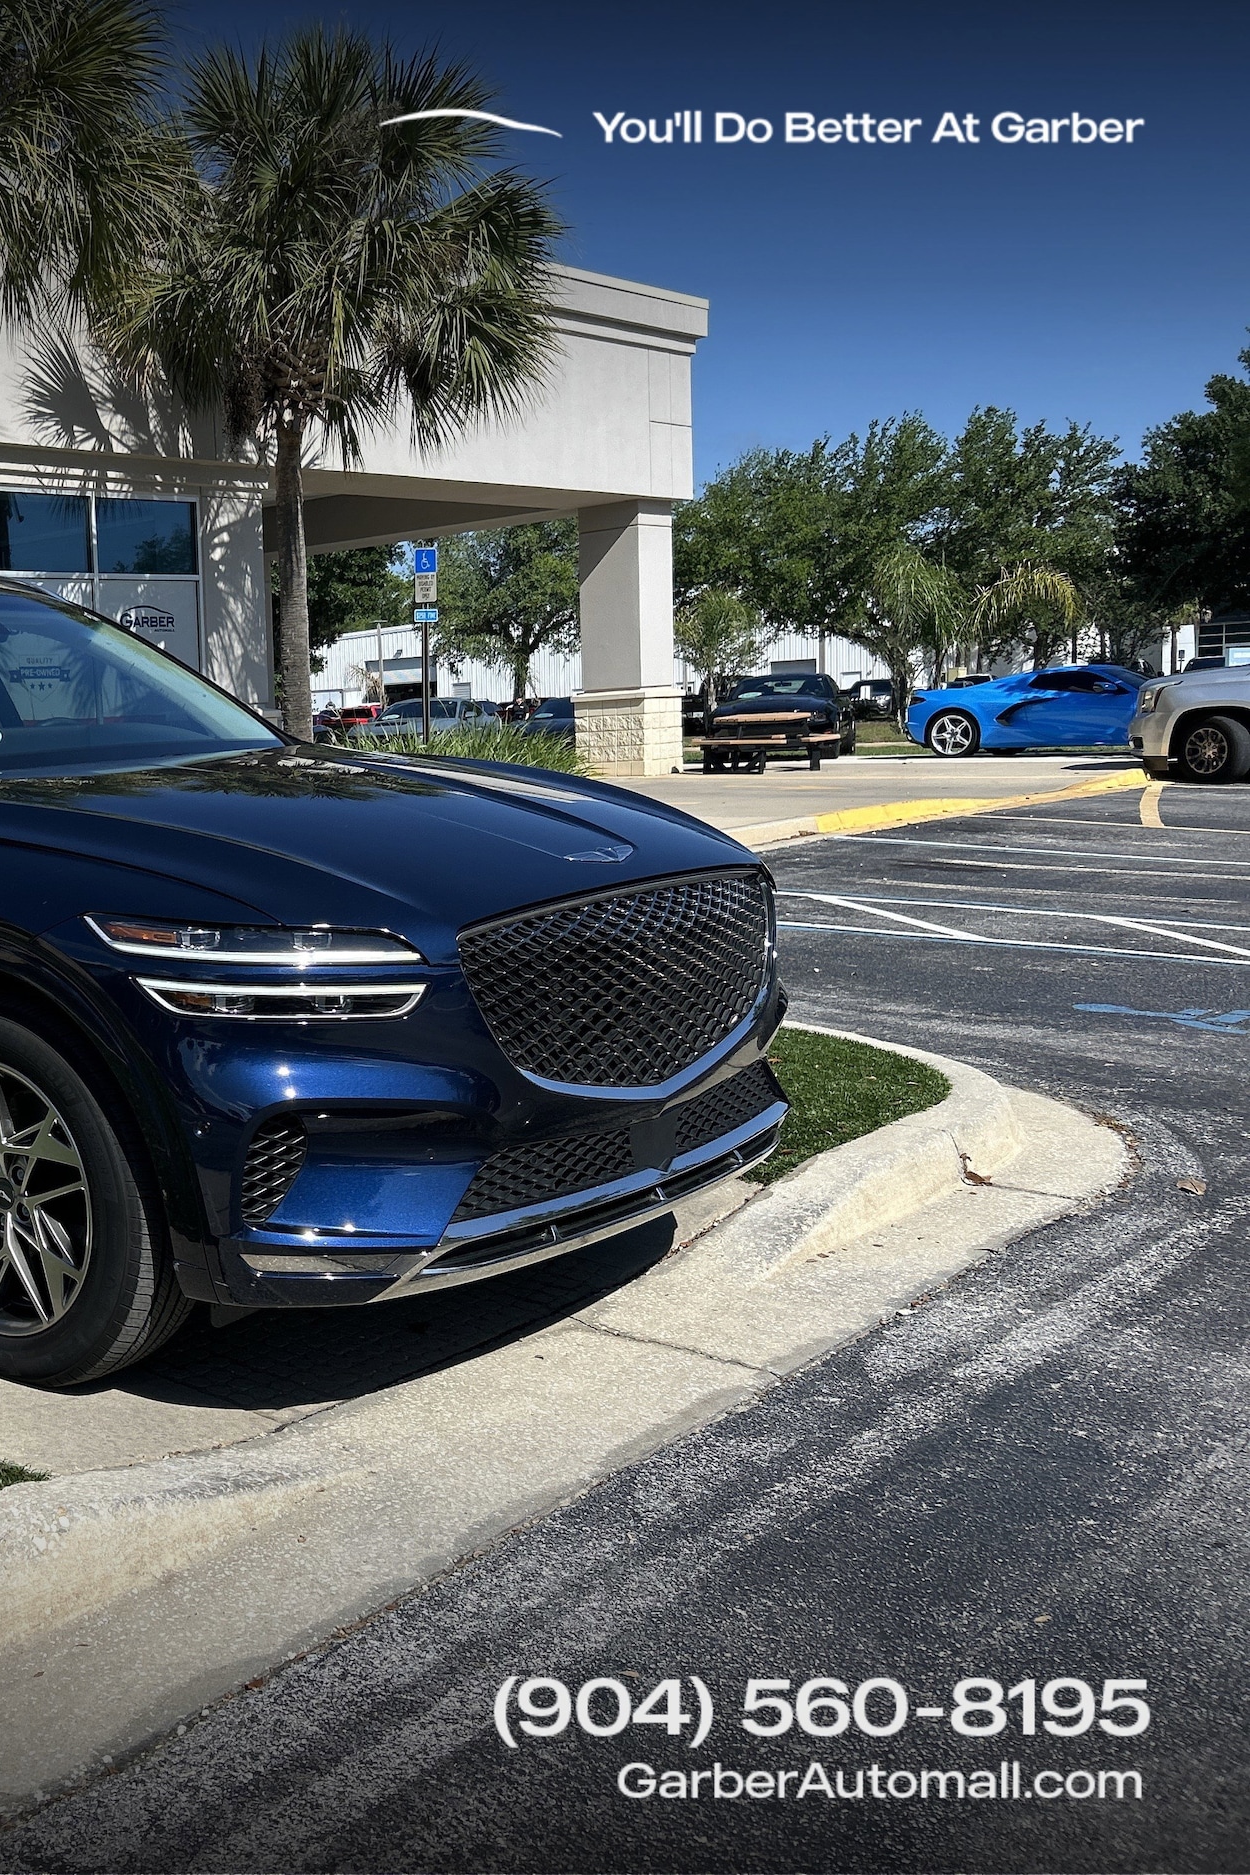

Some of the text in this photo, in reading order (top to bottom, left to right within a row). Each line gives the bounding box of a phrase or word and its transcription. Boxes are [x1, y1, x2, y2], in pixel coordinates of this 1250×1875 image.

[119, 612, 175, 628] GARBER
[26, 657, 53, 665] QUALITY
[20, 668, 61, 677] PRE-OWNED
